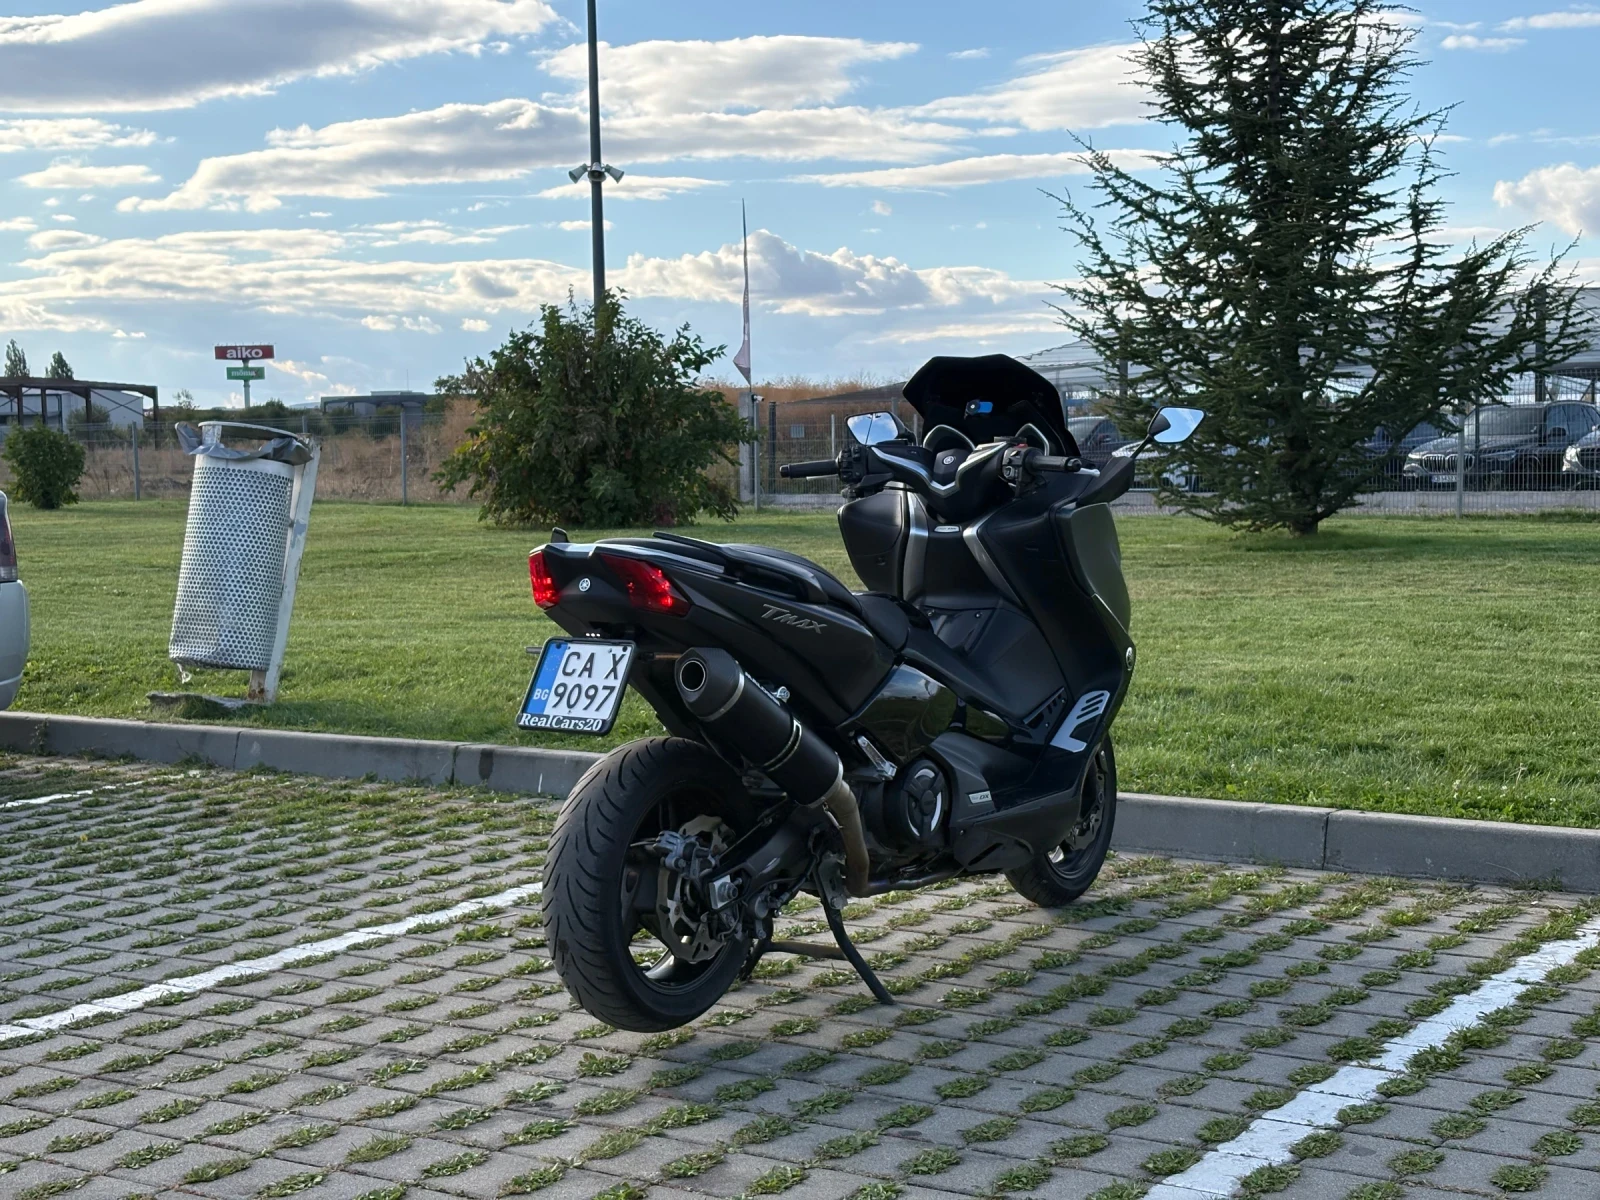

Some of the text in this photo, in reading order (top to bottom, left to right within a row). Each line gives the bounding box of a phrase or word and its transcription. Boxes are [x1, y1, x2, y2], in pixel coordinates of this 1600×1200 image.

[226, 347, 263, 358] aiko
[562, 652, 626, 680] CA X
[533, 688, 549, 701] BG
[552, 682, 616, 711] 9097
[519, 713, 602, 731] RealCars20
